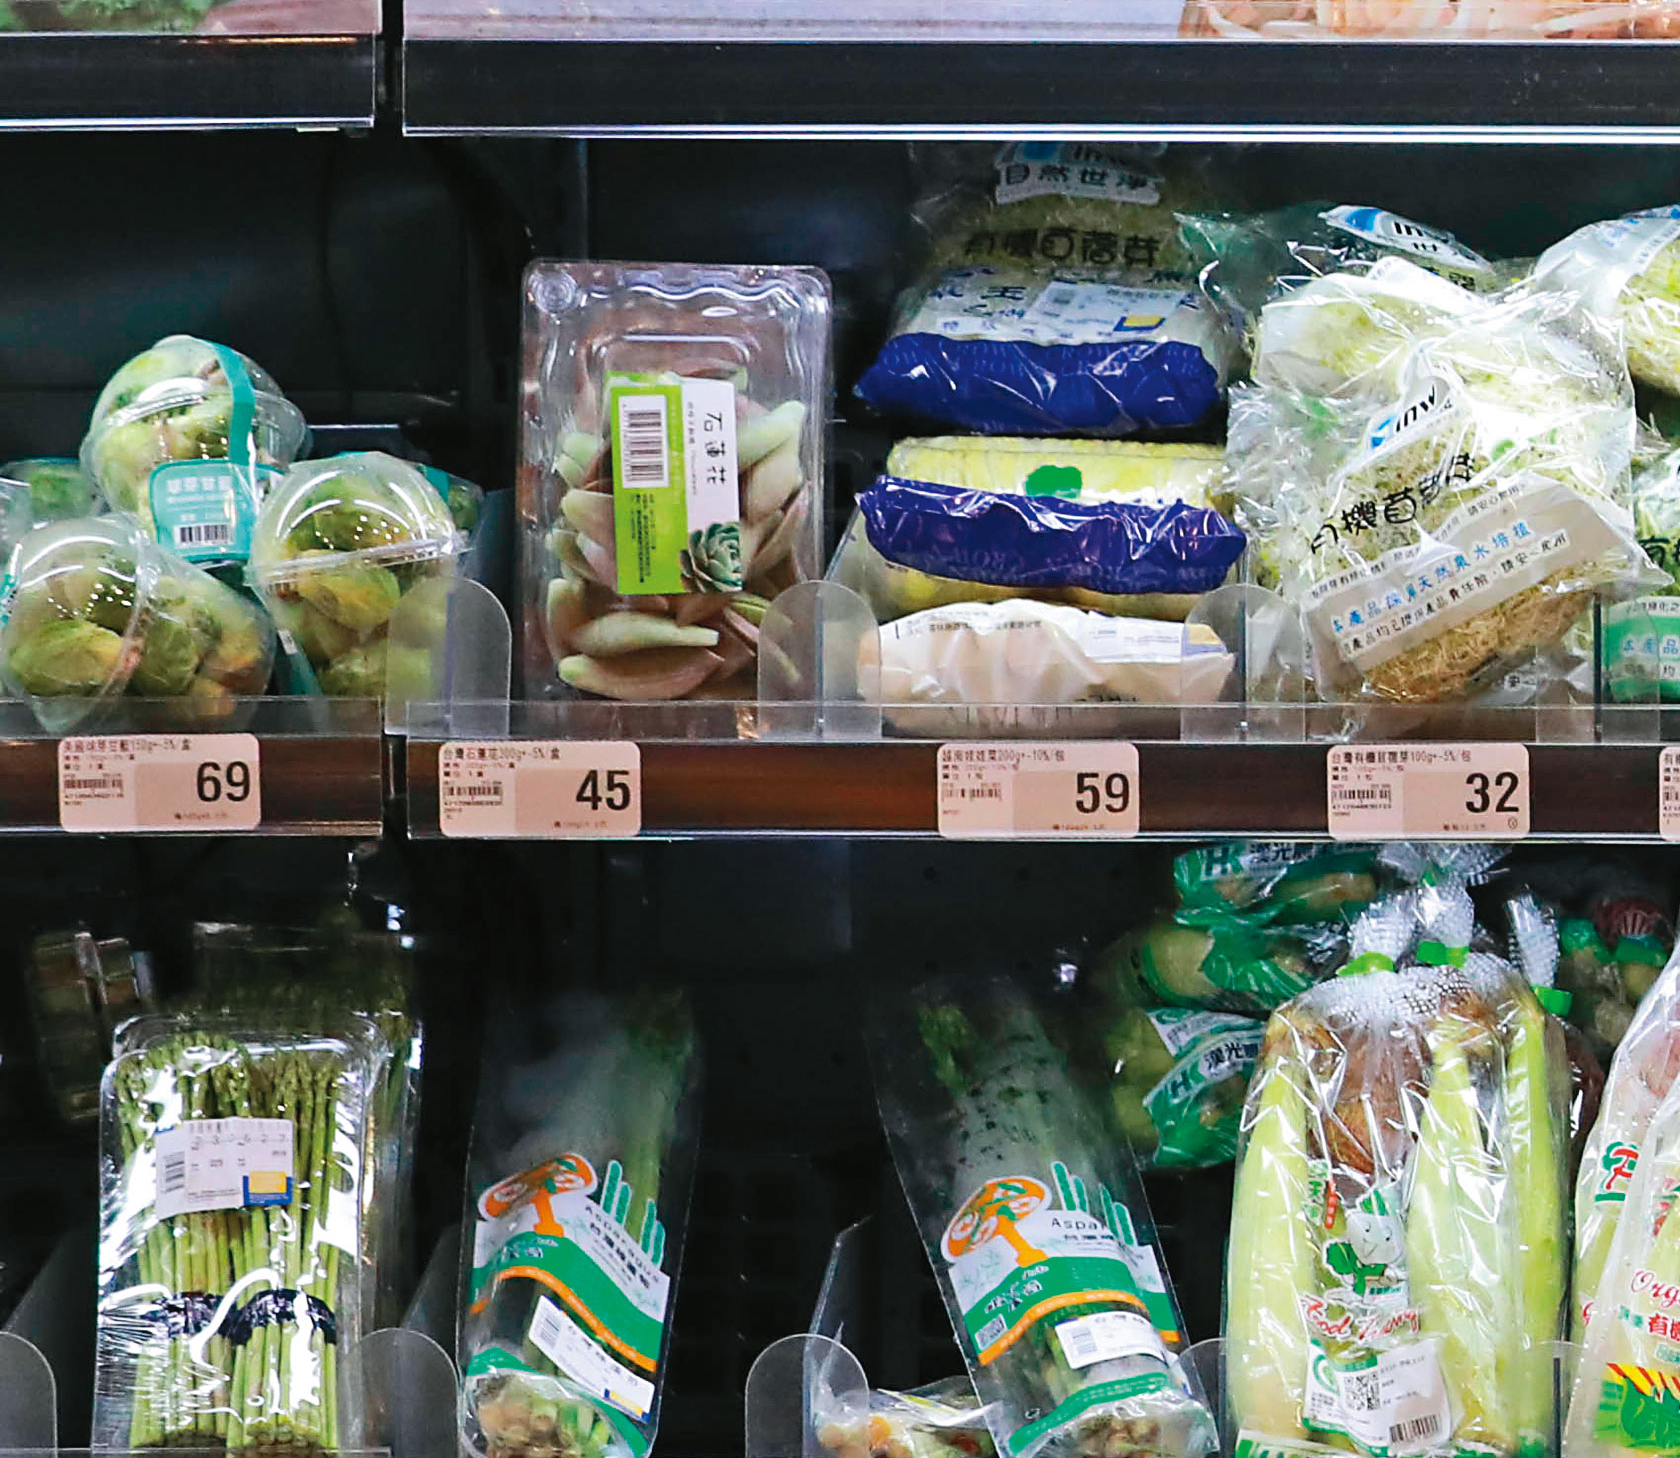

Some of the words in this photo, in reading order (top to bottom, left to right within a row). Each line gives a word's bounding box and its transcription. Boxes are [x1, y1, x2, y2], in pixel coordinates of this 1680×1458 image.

[704, 411, 726, 484] 石蓮花
[197, 762, 250, 802] 69
[576, 770, 630, 810] 45
[1076, 773, 1129, 813] 59
[1466, 772, 1519, 813] 32
